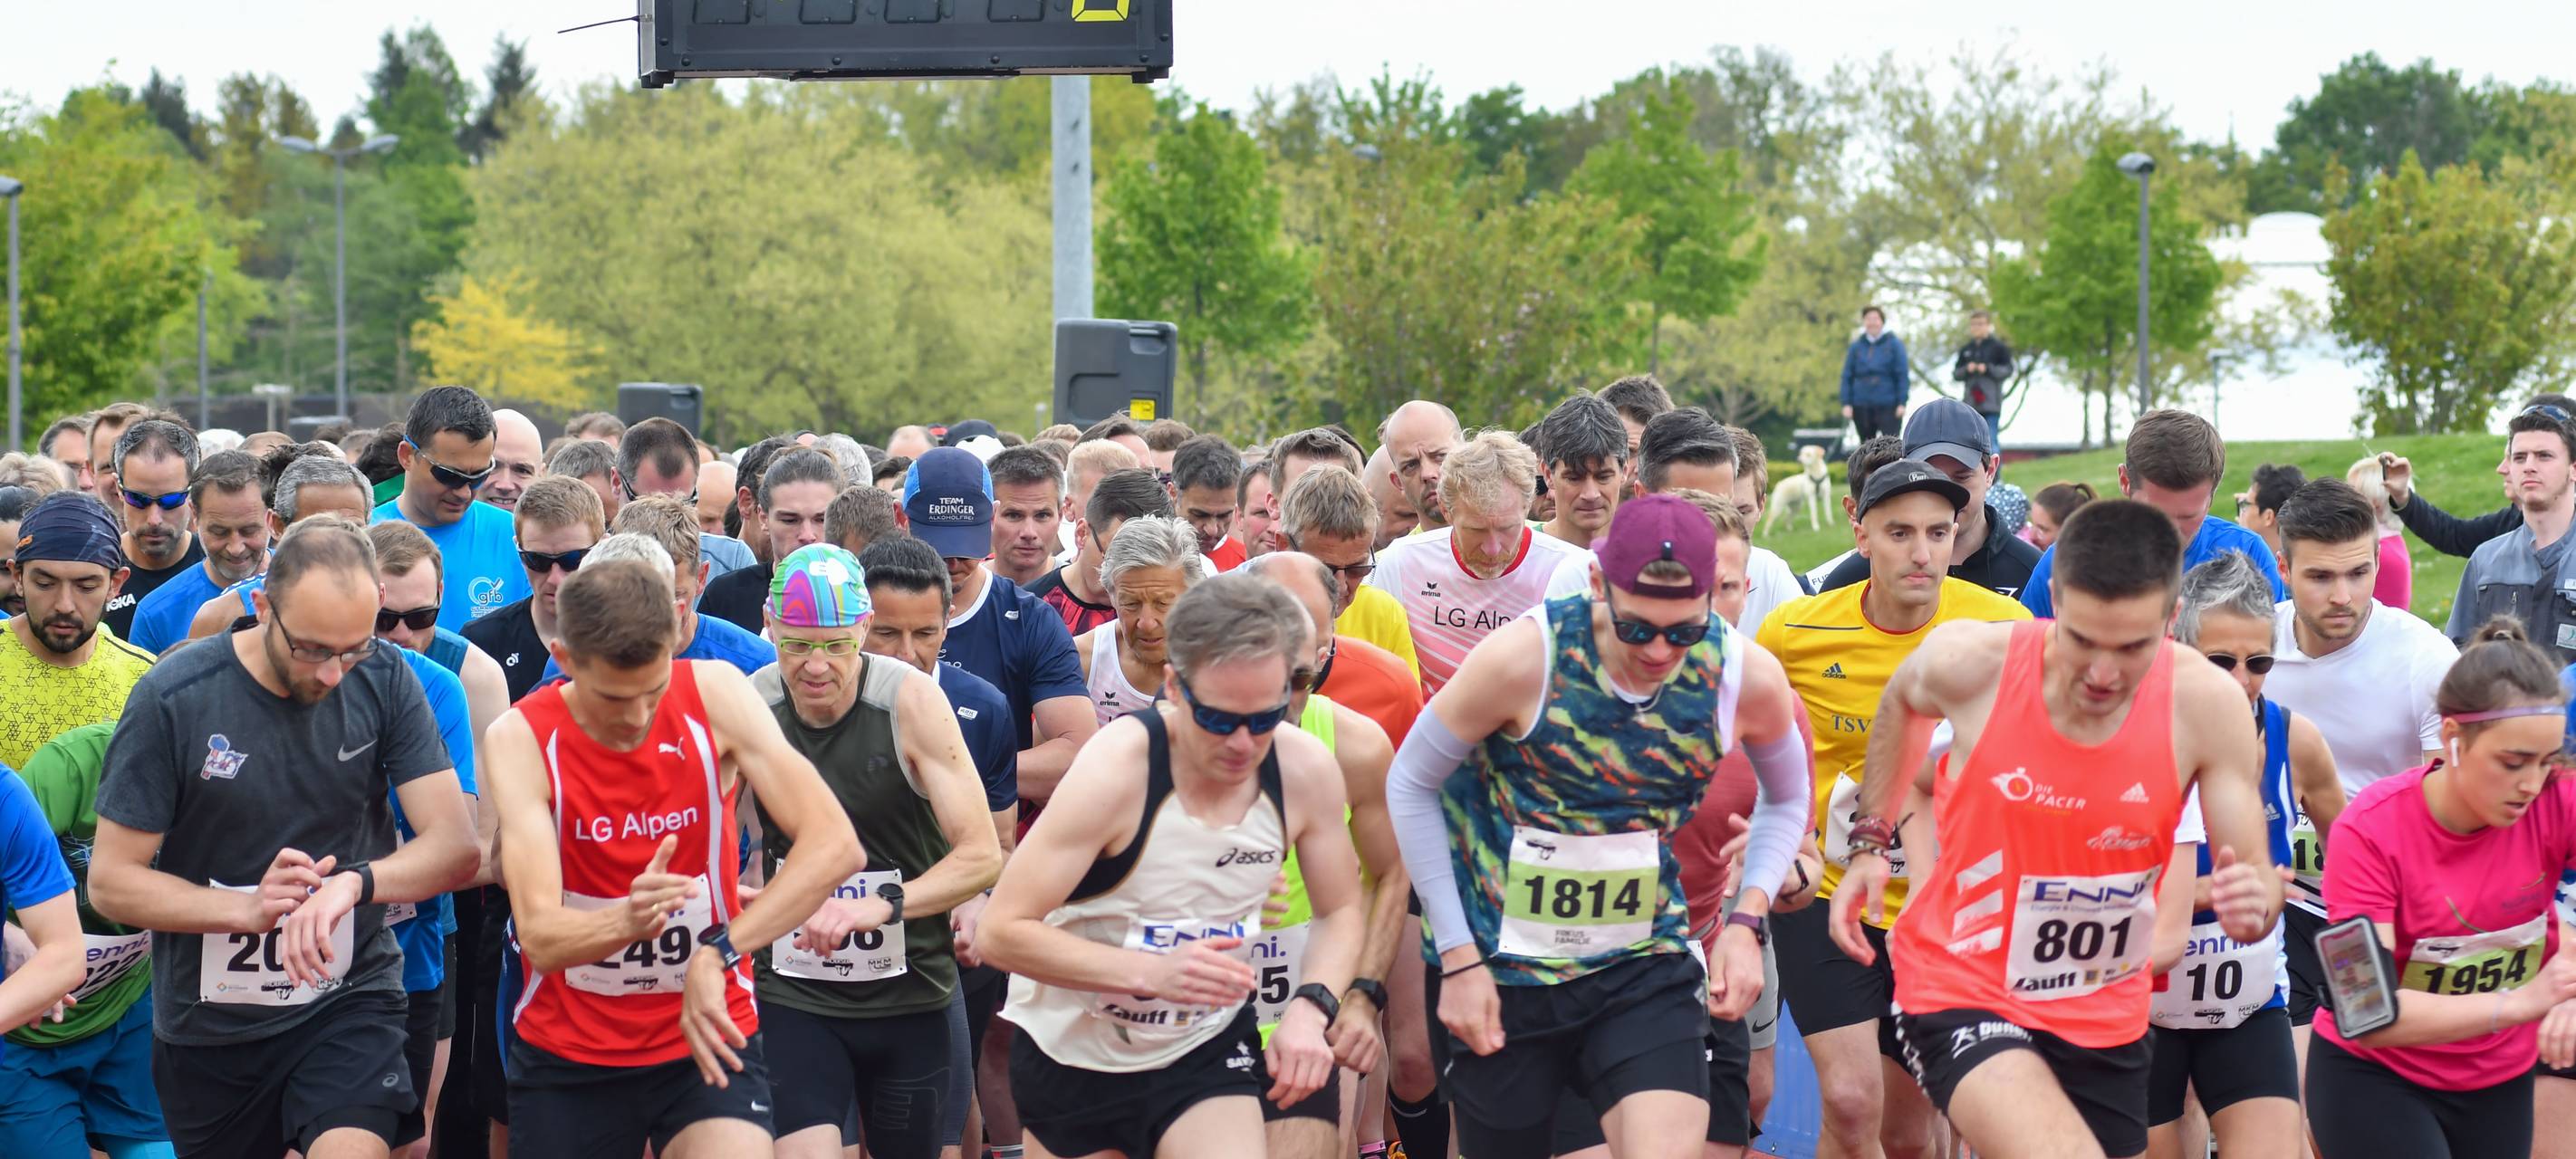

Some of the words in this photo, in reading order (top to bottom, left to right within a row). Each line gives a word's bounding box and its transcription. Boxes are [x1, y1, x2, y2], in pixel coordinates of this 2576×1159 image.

[928, 504, 975, 515] ERDINGER
[478, 589, 503, 605] gfb
[1421, 589, 1440, 598] erima
[1434, 606, 1466, 627] LG
[1831, 714, 1871, 733] TSV
[2034, 793, 2087, 810] PACER
[575, 816, 613, 843] LG
[621, 806, 697, 840] Alpen
[1235, 850, 1275, 864] asics
[1524, 875, 1641, 918] 1814
[226, 926, 327, 972] 20
[592, 925, 691, 969] 49
[2033, 916, 2131, 963] 801
[2185, 934, 2253, 956] enn
[2187, 960, 2243, 1001] 10
[2424, 948, 2528, 996] 1954
